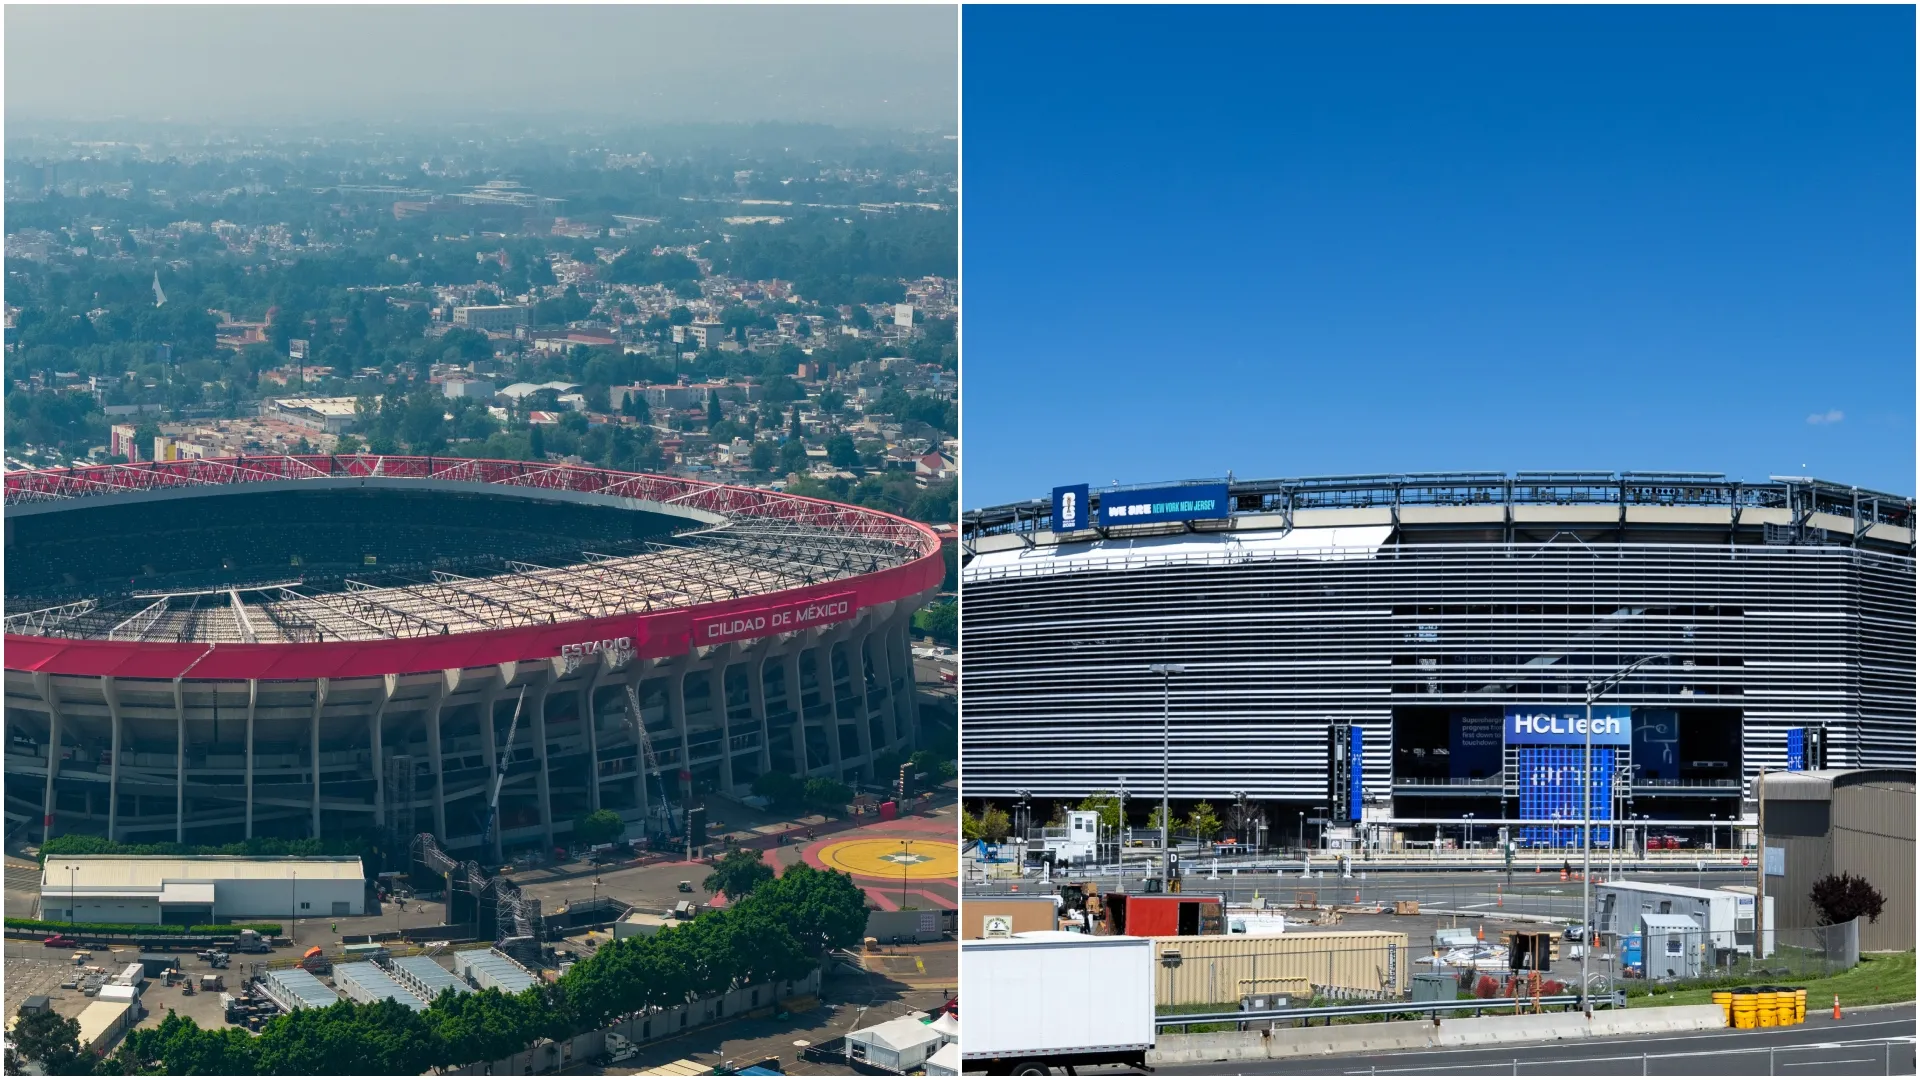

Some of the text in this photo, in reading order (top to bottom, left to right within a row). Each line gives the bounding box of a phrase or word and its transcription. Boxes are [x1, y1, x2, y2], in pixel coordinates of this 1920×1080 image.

[1108, 499, 1216, 517] WE ARE NEW YORK NEW JERSEY
[708, 601, 848, 638] CIUDAD DE MÉXICO
[561, 636, 632, 657] ESTADIO
[1515, 713, 1620, 734] HCLTech
[1170, 853, 1178, 863] D
